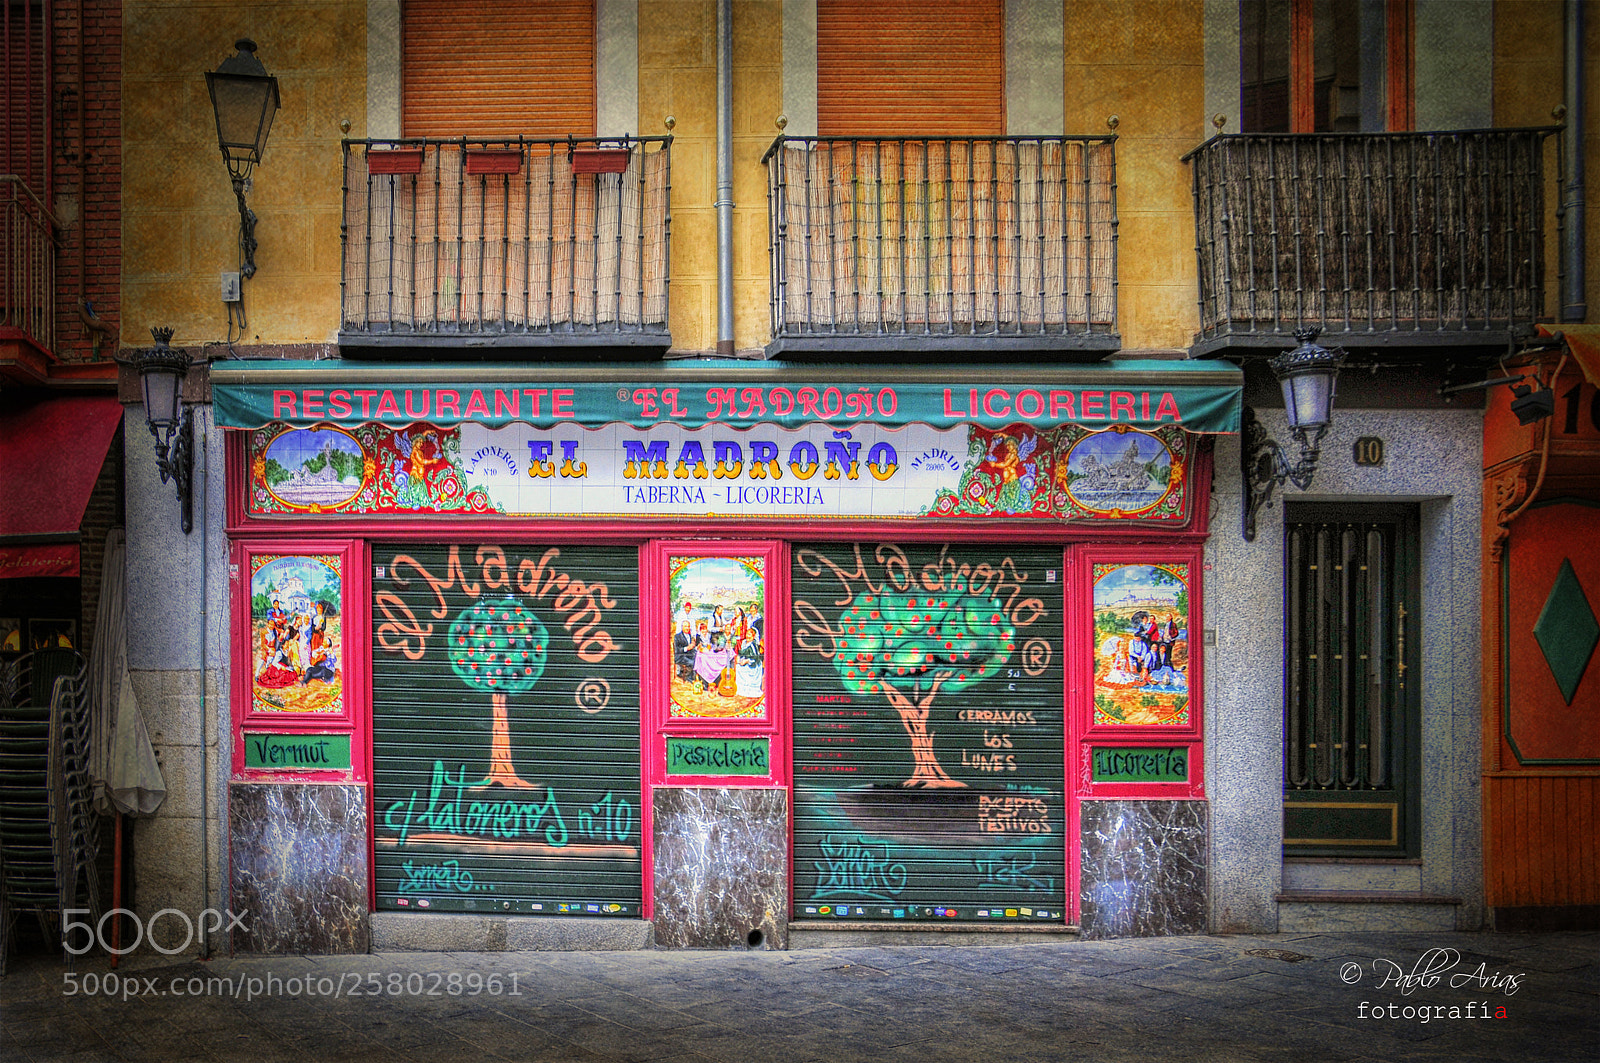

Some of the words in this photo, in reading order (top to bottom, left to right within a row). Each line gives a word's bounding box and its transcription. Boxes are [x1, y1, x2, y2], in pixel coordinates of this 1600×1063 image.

[272, 389, 575, 419] RESTAURANTE
[632, 388, 688, 418] EL
[706, 387, 898, 420] MADROÑO
[943, 388, 1183, 422] LICORERIA
[465, 445, 519, 476] LATONEROS
[527, 440, 588, 479] EL
[622, 430, 900, 481] MADROÑO
[911, 448, 960, 471] MADRID
[1357, 441, 1380, 463] 10
[623, 486, 706, 504] TABERNA
[725, 486, 825, 505] LICORERIA
[958, 709, 1037, 726] CERRAMOS
[254, 735, 330, 763] Vermut
[961, 749, 1018, 772] LUNES
